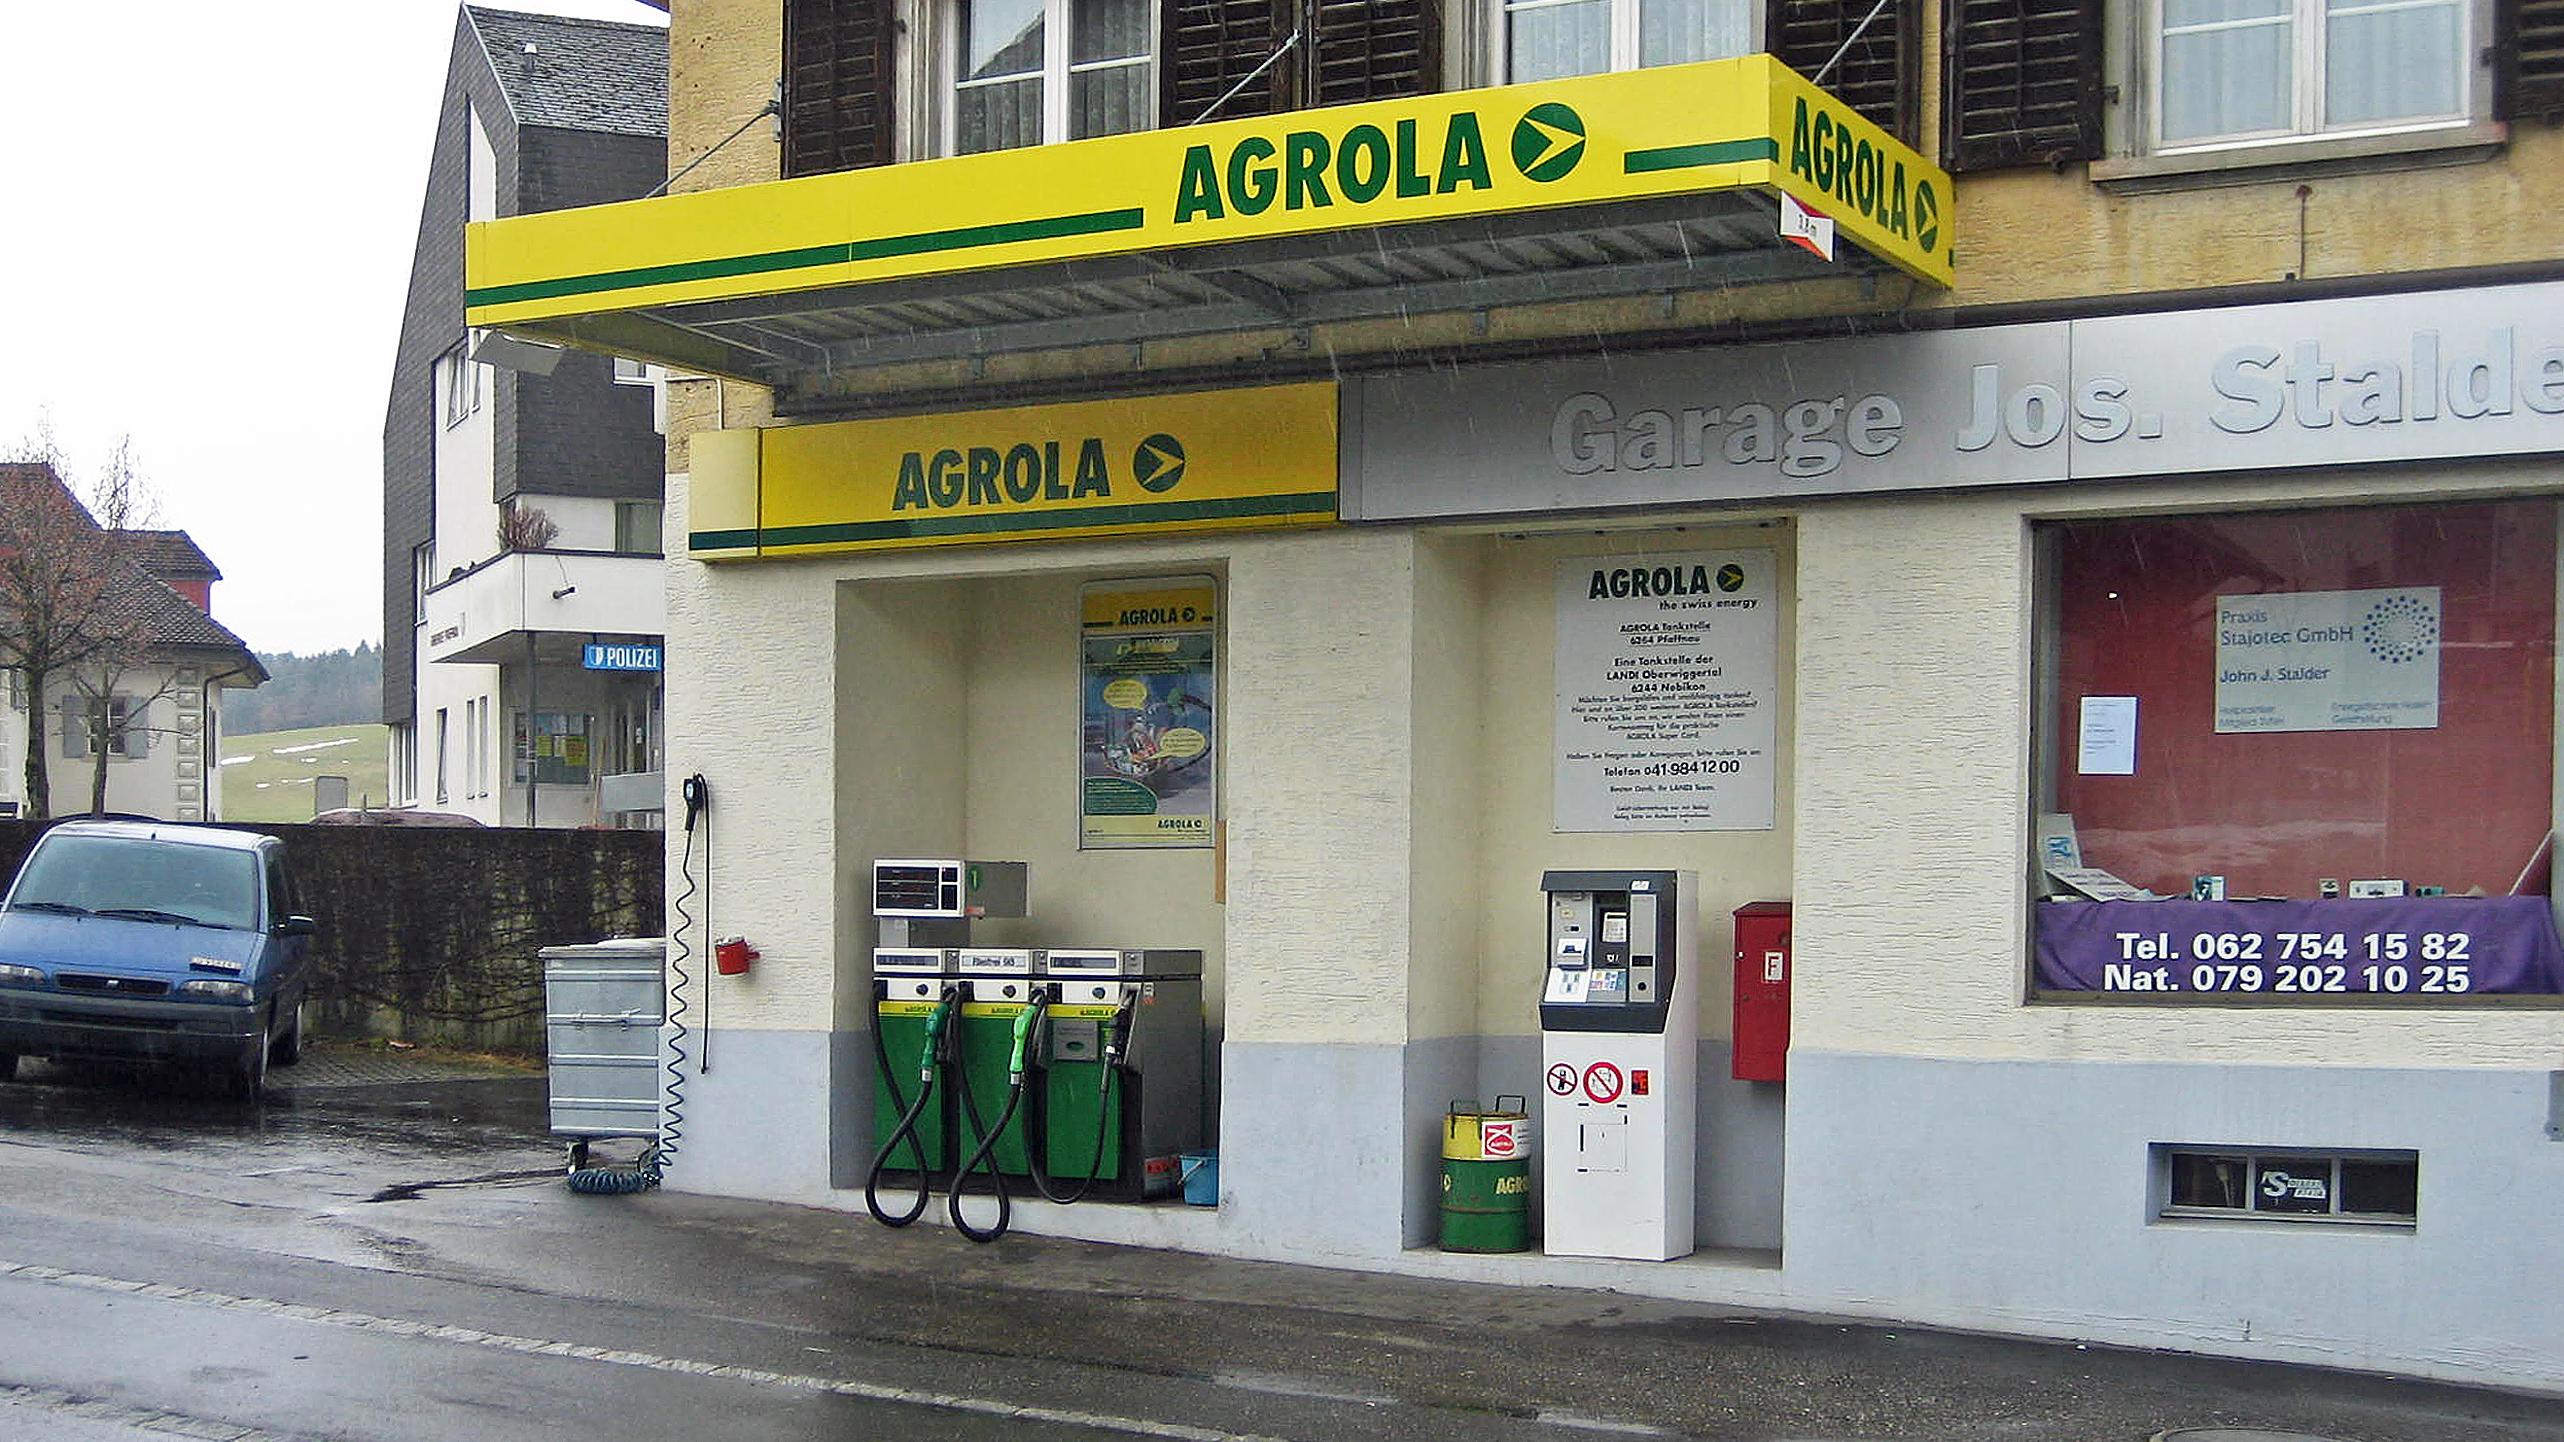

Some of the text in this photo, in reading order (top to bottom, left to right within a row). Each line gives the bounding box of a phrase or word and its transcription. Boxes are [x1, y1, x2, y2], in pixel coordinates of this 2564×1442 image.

[1174, 112, 1492, 224] AGROLA
[1791, 96, 1909, 242] AGROLA
[1549, 391, 1903, 478] Garage
[1955, 363, 2164, 443] Jos.
[892, 437, 1111, 511] AGROLA
[1588, 565, 1711, 599] AGROLA
[1659, 598, 1758, 611] the swiss energy
[1120, 607, 1178, 626] AGROLA
[1619, 621, 1711, 632] AGROLA Tankstelle
[2221, 609, 2268, 624] Praxis
[2221, 625, 2353, 647] Stajotec GmbH
[607, 647, 657, 668] POLIZEI
[1614, 655, 1713, 667] Eine Tankstelle der
[1606, 668, 1722, 680] LANDI Oberwiggertal
[2220, 666, 2331, 683] John J. Stalder
[1632, 683, 1706, 693] 6244 Nebikon
[1604, 768, 1640, 776] Telefon
[2116, 932, 2470, 960] Tel. 062 754 15 82
[1768, 956, 1779, 976] F
[2104, 964, 2470, 992] Nat. 079 202 10 25
